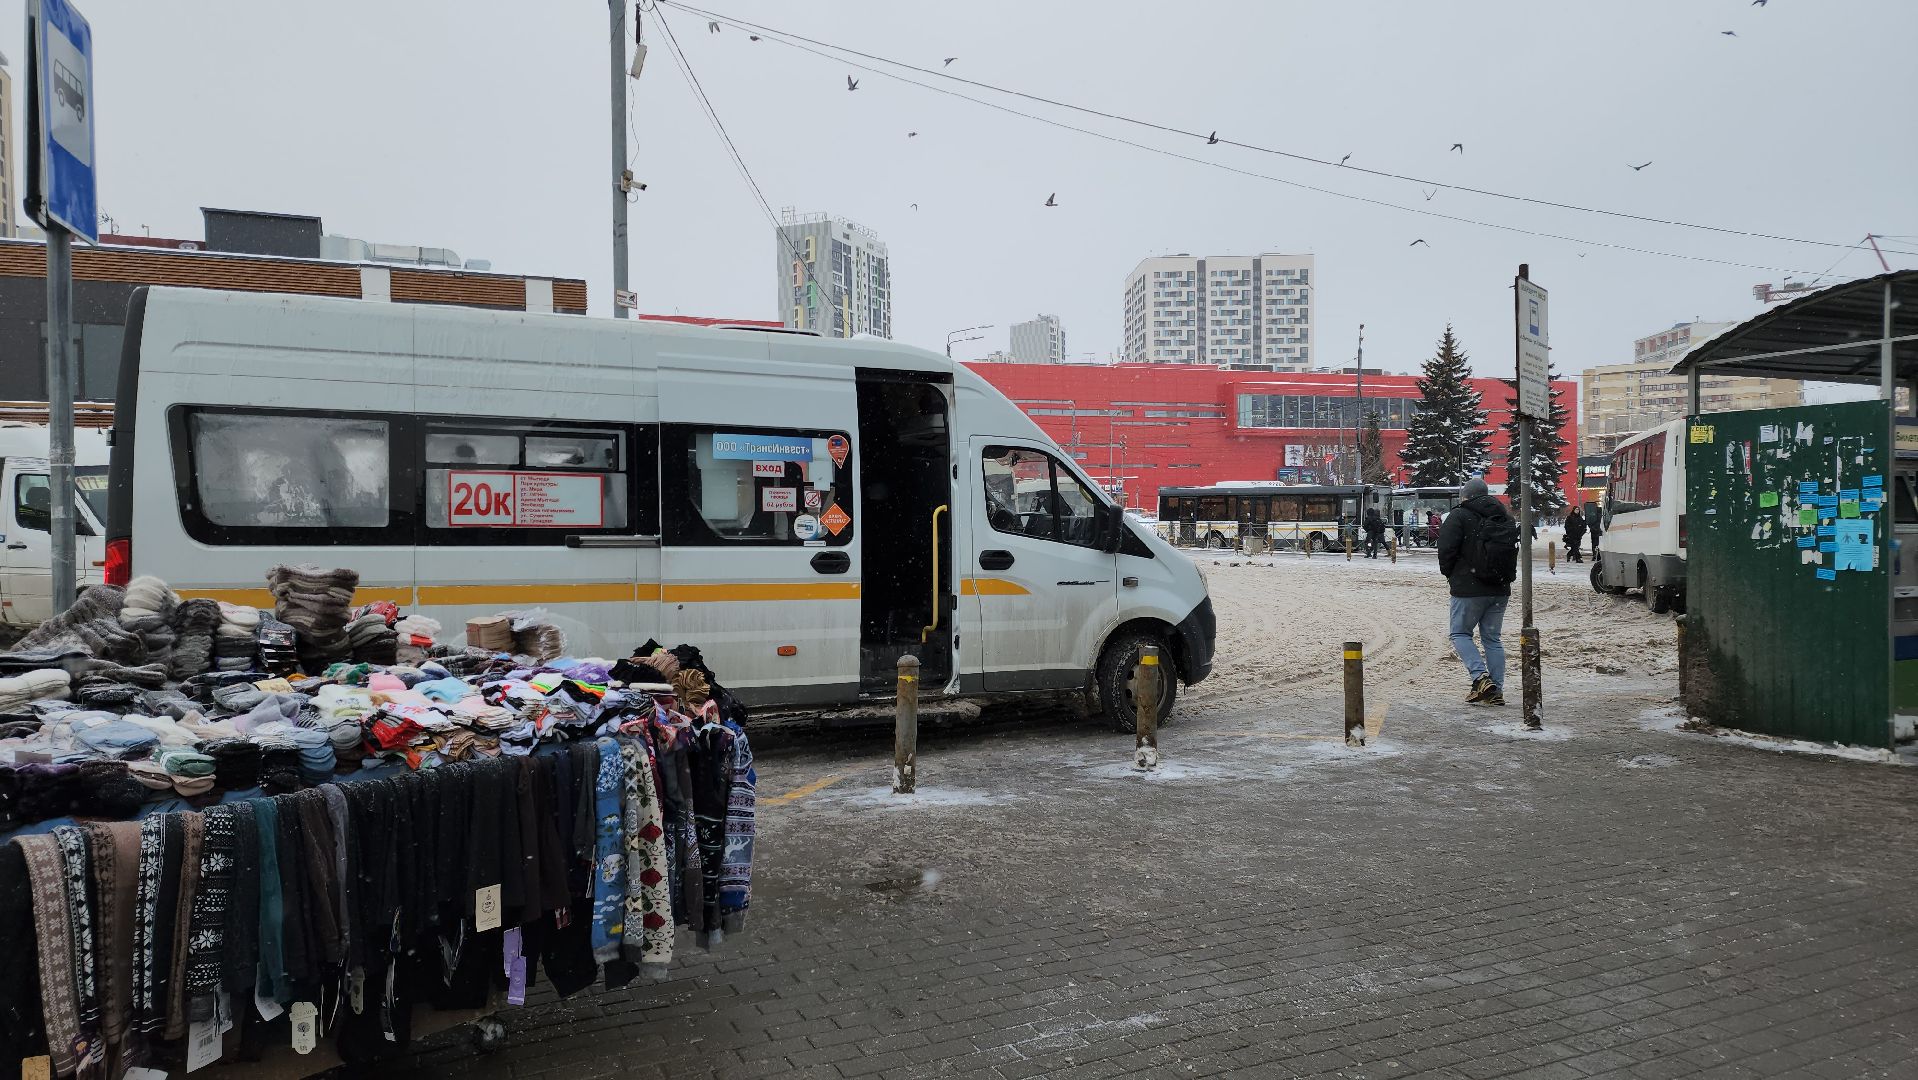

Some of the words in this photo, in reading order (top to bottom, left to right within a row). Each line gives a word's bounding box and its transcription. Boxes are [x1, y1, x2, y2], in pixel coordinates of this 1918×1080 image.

[716, 441, 737, 452] ООО
[755, 464, 782, 474] ВХОД
[453, 482, 511, 516] 20к
